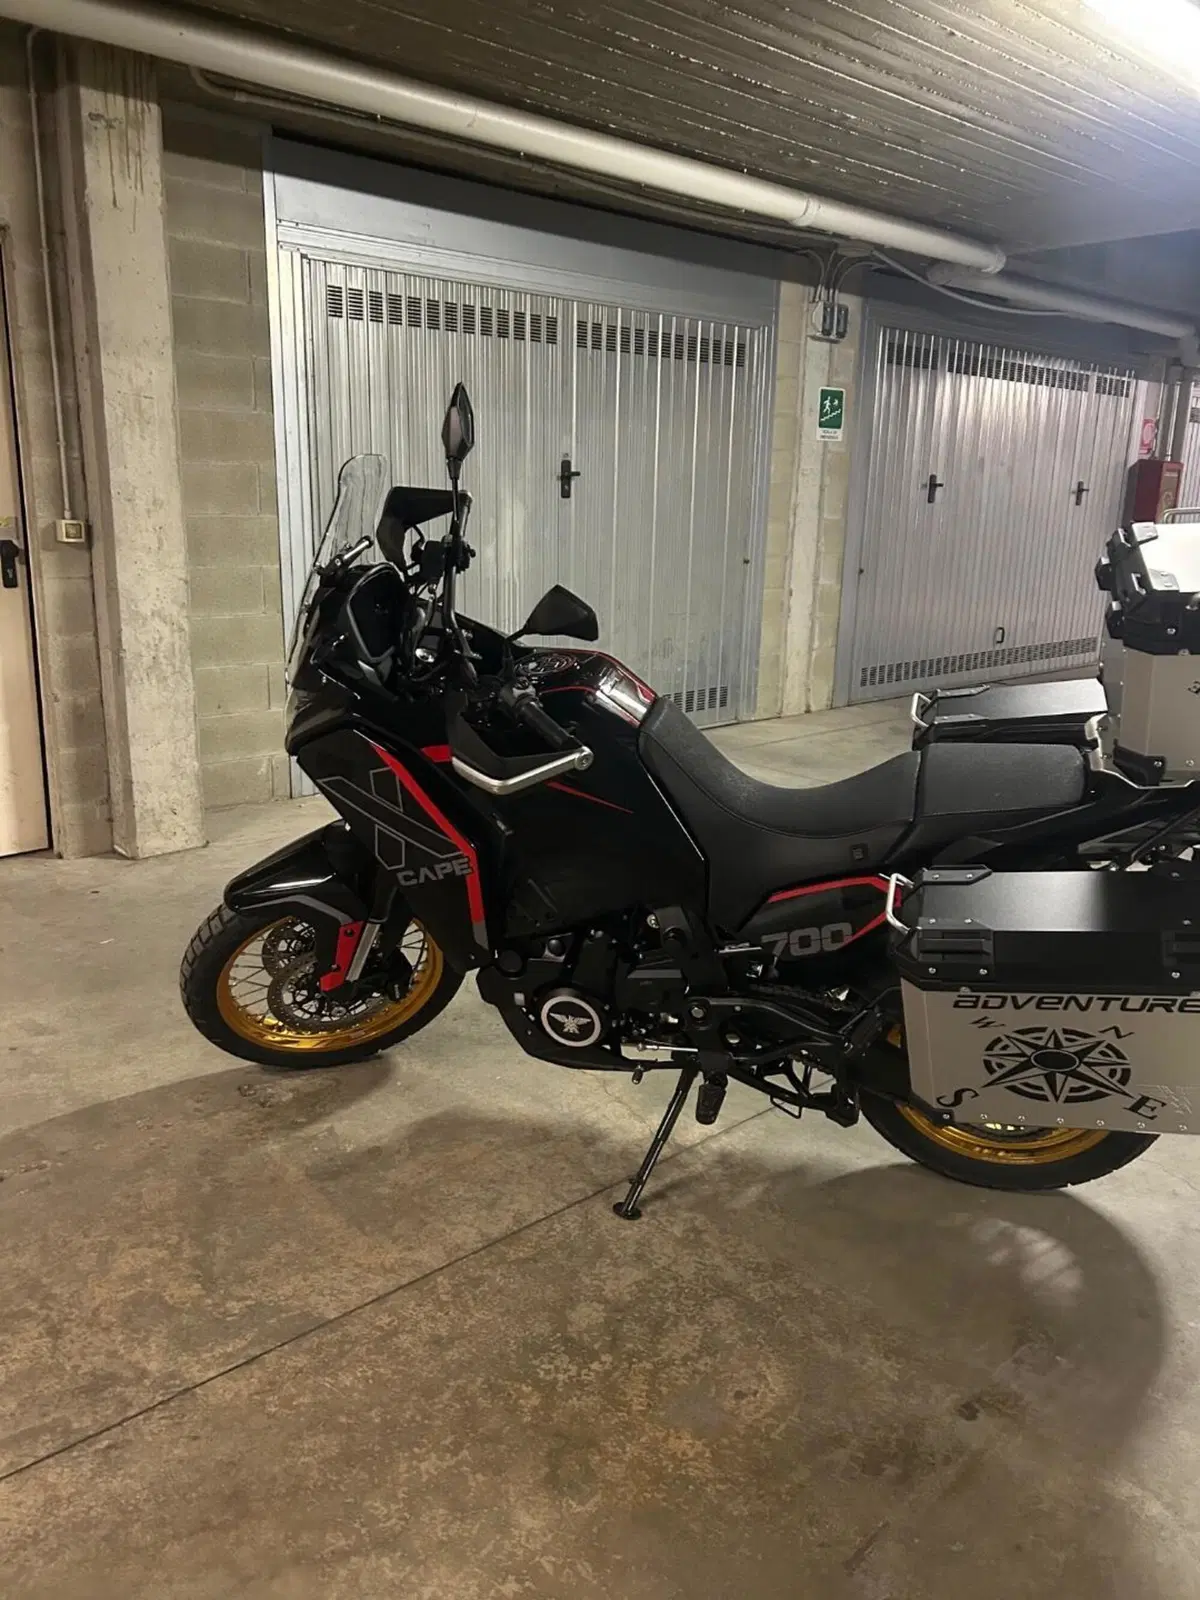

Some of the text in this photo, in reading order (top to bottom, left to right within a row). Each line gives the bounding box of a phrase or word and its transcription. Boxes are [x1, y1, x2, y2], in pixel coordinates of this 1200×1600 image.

[396, 857, 472, 886] CAPE
[761, 922, 853, 957] 700
[936, 1087, 980, 1108] S
[1123, 1093, 1167, 1121] E
